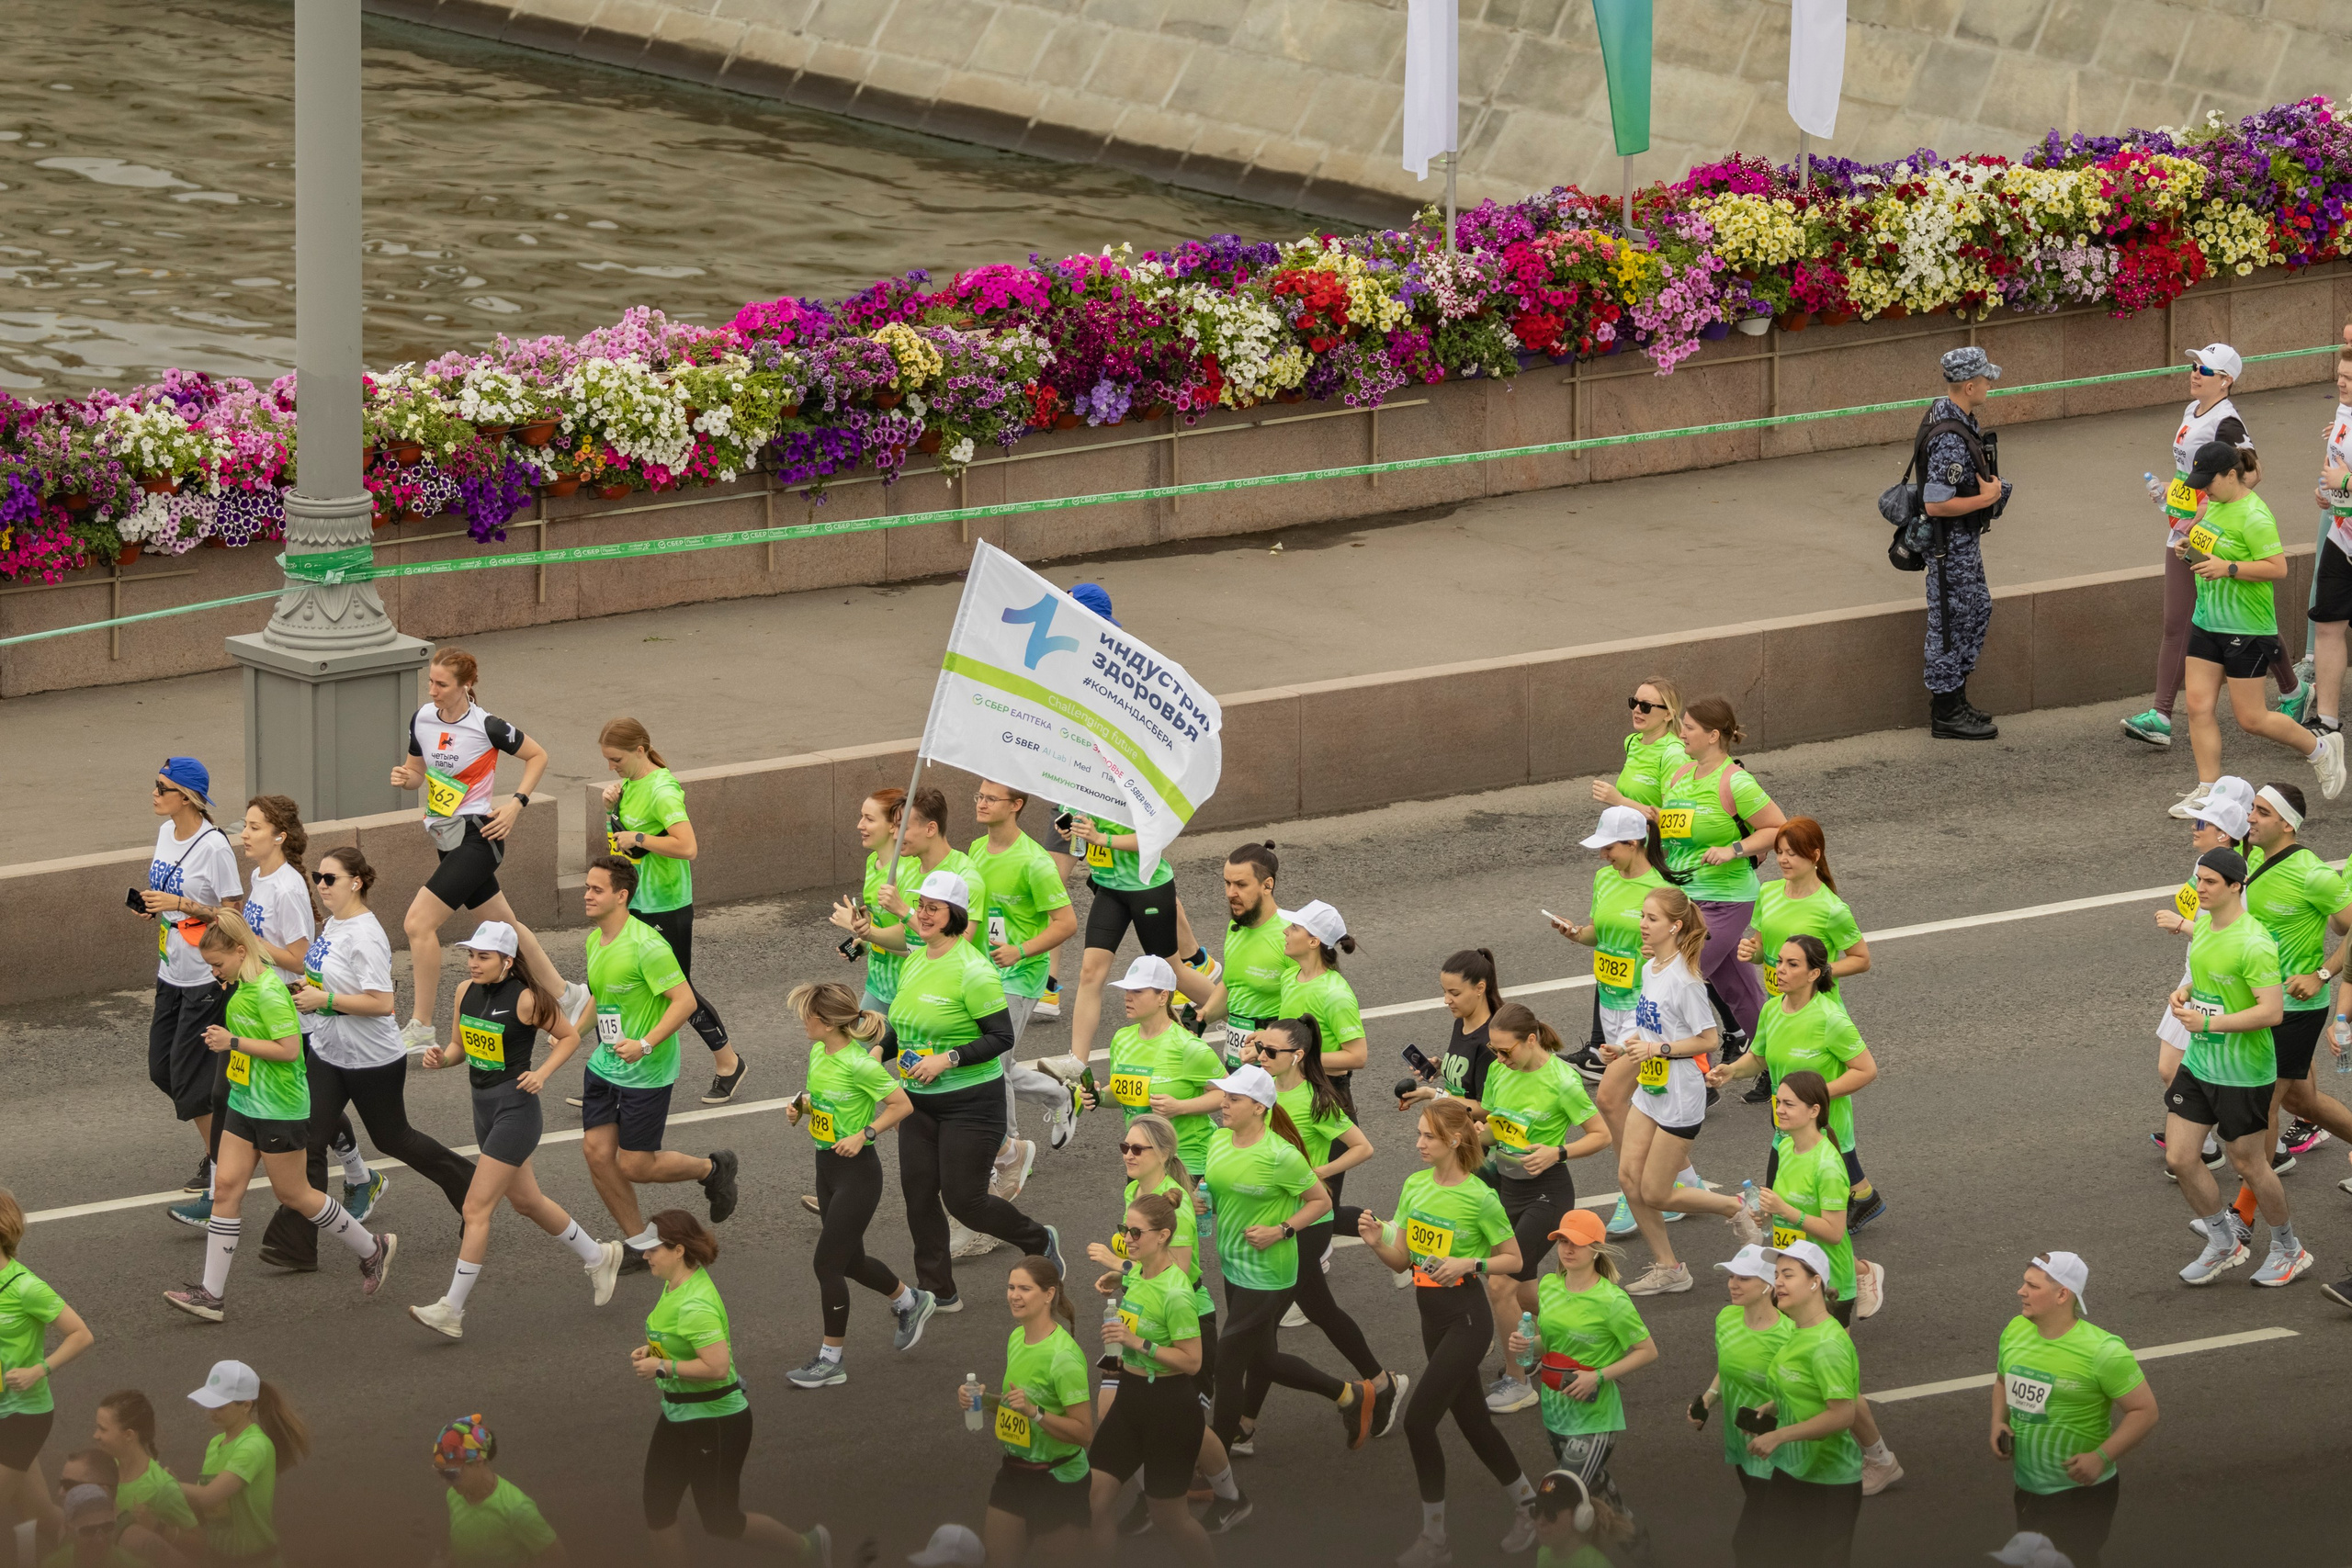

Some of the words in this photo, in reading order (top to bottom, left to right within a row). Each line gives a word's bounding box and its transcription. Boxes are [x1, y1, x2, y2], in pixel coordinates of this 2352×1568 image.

[2192, 530, 2212, 550] 2587
[985, 699, 1009, 714] СБЕР
[1011, 709, 1053, 731] ЕАПТЕКА
[1082, 677, 1174, 751] #КОМАНДАСБЕРА
[1048, 694, 1110, 738] Challenging
[1112, 729, 1137, 761] future
[1070, 733, 1091, 748] СБЕР
[1014, 737, 1040, 751] SBER
[1053, 750, 1067, 762] Lab
[1073, 761, 1091, 773] Med
[1130, 786, 1145, 805] SBER
[1661, 814, 1687, 829] 2373
[2179, 887, 2197, 911] 4348
[1599, 957, 1628, 977] 3782
[465, 1031, 496, 1052] 5898
[1227, 1029, 1246, 1048] 3286
[2194, 1032, 2209, 1042] 4,2км
[1114, 1078, 1143, 1097] 2818
[1411, 1225, 1443, 1249] 3091
[2012, 1381, 2045, 1404] 4058
[1000, 1413, 1025, 1435] 3490
